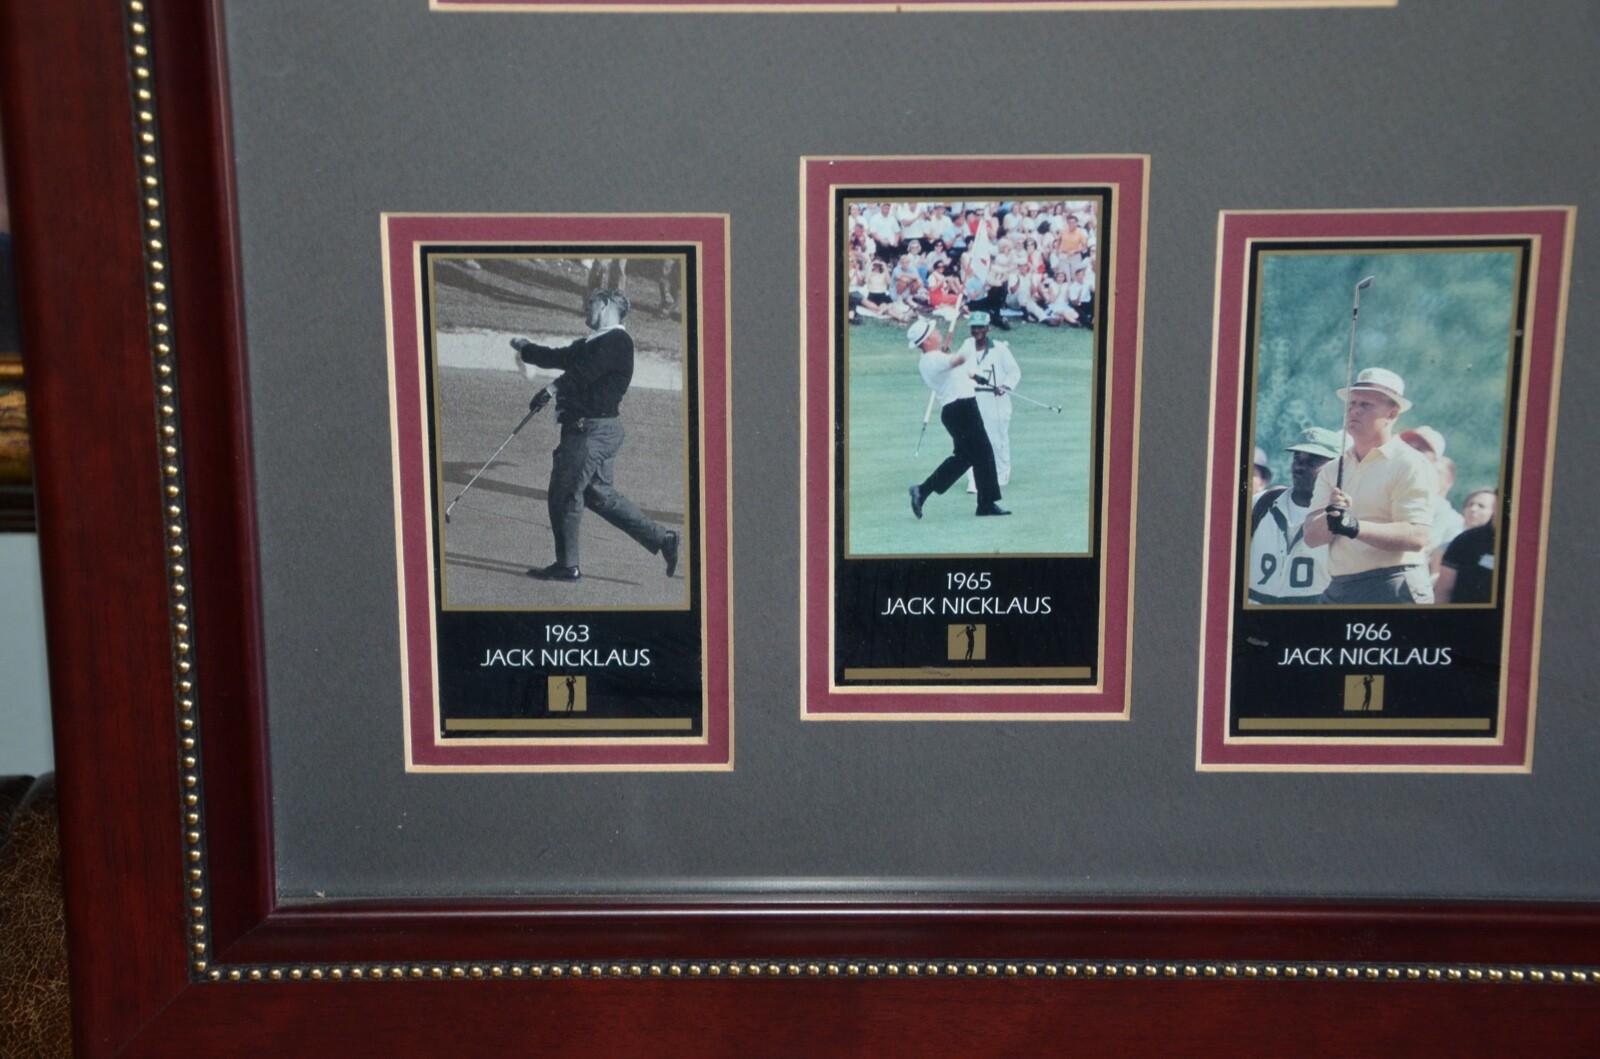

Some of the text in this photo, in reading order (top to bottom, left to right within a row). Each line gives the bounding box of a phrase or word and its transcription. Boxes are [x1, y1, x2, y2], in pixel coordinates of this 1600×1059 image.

[1257, 553, 1314, 588] 90
[946, 572, 992, 591] 1965
[881, 596, 1053, 616] JACK NICKLAUS
[544, 624, 590, 643] 1963
[1345, 622, 1392, 641] 1966
[480, 648, 651, 667] JACK NICKLAUS
[1277, 647, 1452, 666] JACK NICKLAUS
